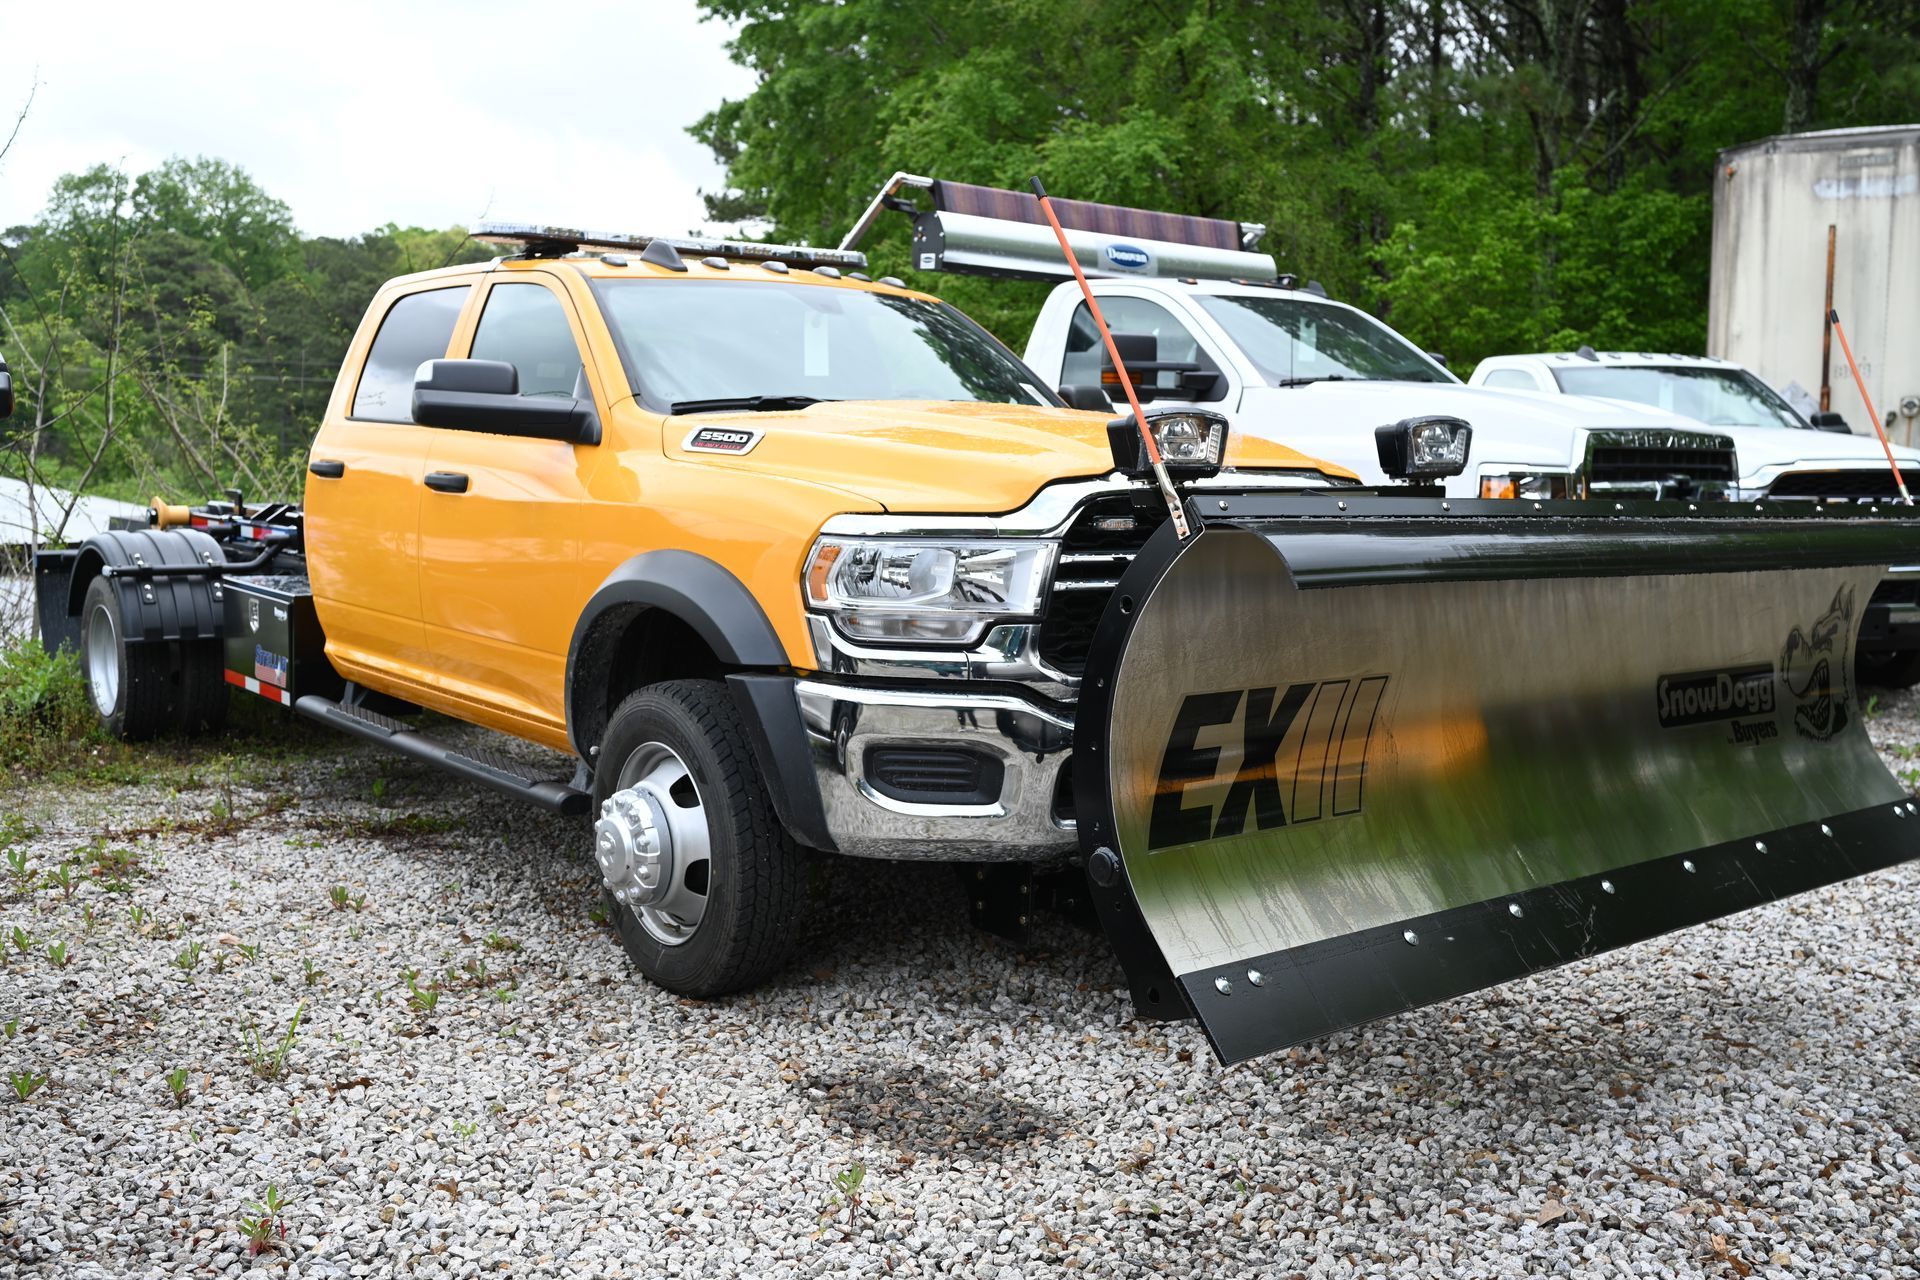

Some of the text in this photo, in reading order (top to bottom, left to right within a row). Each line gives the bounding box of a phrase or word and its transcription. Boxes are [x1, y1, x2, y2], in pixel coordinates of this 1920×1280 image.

[1106, 247, 1149, 263] Donovan
[700, 431, 749, 443] 5500
[1659, 673, 1773, 719] SnowDogg
[1731, 719, 1778, 746] Buyers
